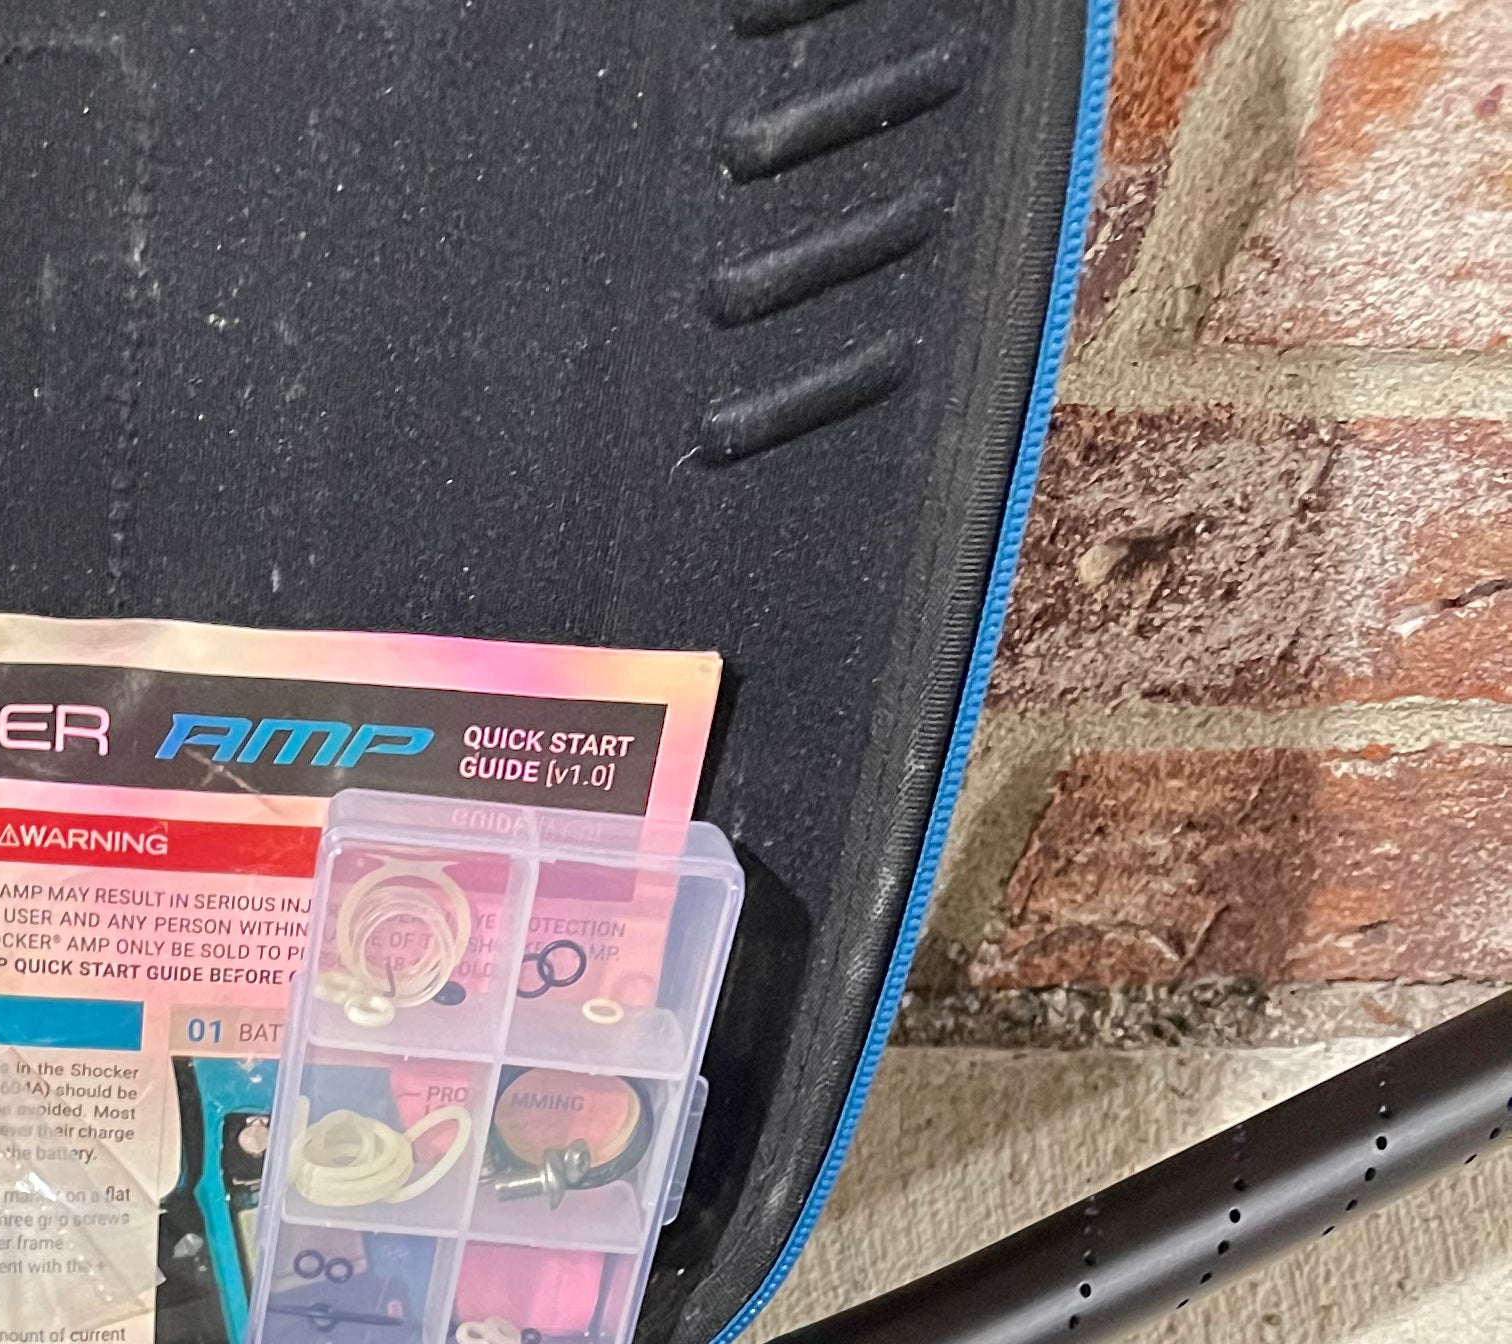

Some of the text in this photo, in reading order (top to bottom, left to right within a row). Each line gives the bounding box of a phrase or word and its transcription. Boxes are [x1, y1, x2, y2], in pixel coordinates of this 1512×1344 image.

[154, 712, 435, 769] AMP
[462, 724, 635, 758] QUICK START
[458, 755, 616, 790] GUIDE [v1.0]
[17, 823, 169, 856] WARNING
[3, 907, 53, 926] USER
[59, 911, 100, 929] AND
[106, 913, 148, 931] ANY
[154, 917, 232, 936] PERSON
[238, 919, 309, 938] WITHIN
[47, 886, 91, 903] MAY
[94, 887, 166, 908] RESULT
[169, 893, 189, 909] IN
[193, 893, 276, 912] SERIOUS
[280, 897, 312, 915] INJ
[474, 913, 497, 929] YE
[528, 915, 627, 938] OTECTION
[66, 937, 110, 954] AMP
[116, 939, 166, 958] ONLY
[170, 941, 195, 958] BE
[200, 943, 250, 960] SOLD
[255, 944, 281, 961] TO
[14, 957, 73, 976] QUICK
[79, 961, 141, 980] START
[146, 964, 203, 983] GUIDE
[209, 967, 284, 985] BEFORE
[186, 1018, 285, 1044] 01 BAT
[15, 1061, 31, 1074] in
[37, 1061, 64, 1076] the
[70, 1062, 140, 1080] Shocker
[55, 1082, 113, 1099] should
[117, 1084, 138, 1100] be
[425, 1085, 586, 1113] PROMMING
[93, 1105, 136, 1121] Most
[78, 1125, 135, 1143] charge
[105, 1185, 131, 1202] flat
[17, 1234, 64, 1251] frame
[28, 1259, 62, 1274] with
[49, 1327, 66, 1344] of
[70, 1326, 126, 1343] current
